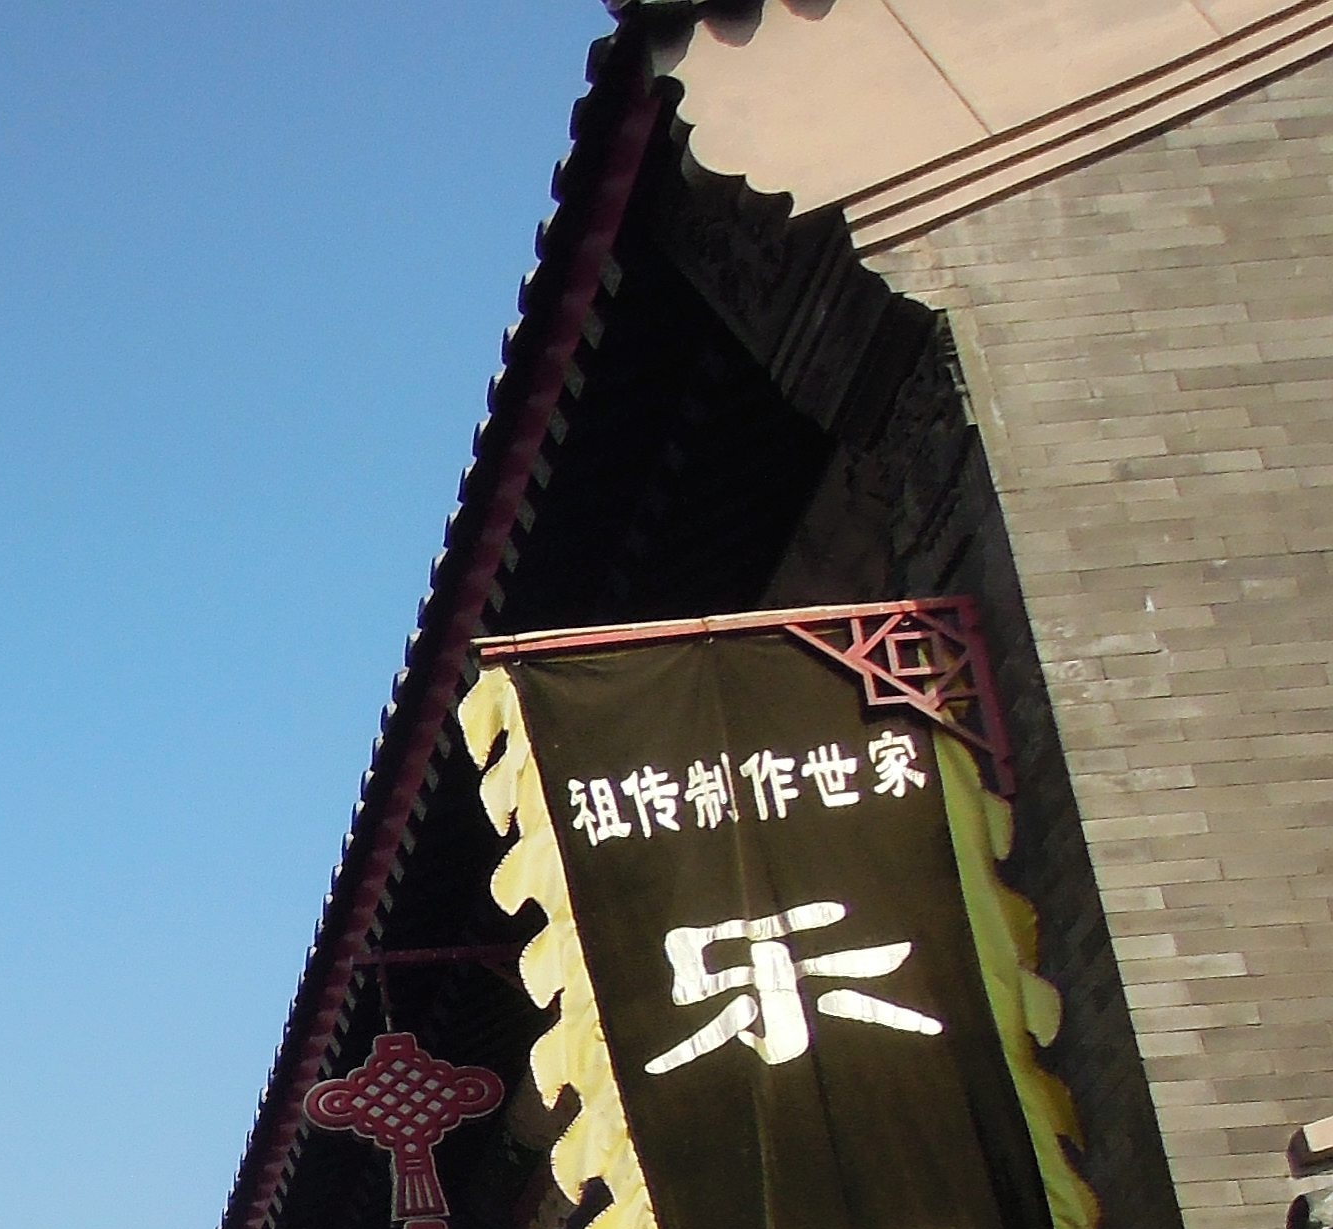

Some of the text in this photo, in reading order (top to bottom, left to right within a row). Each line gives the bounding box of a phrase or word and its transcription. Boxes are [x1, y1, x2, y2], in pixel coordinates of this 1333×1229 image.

[568, 729, 927, 846] 祖传制作世家
